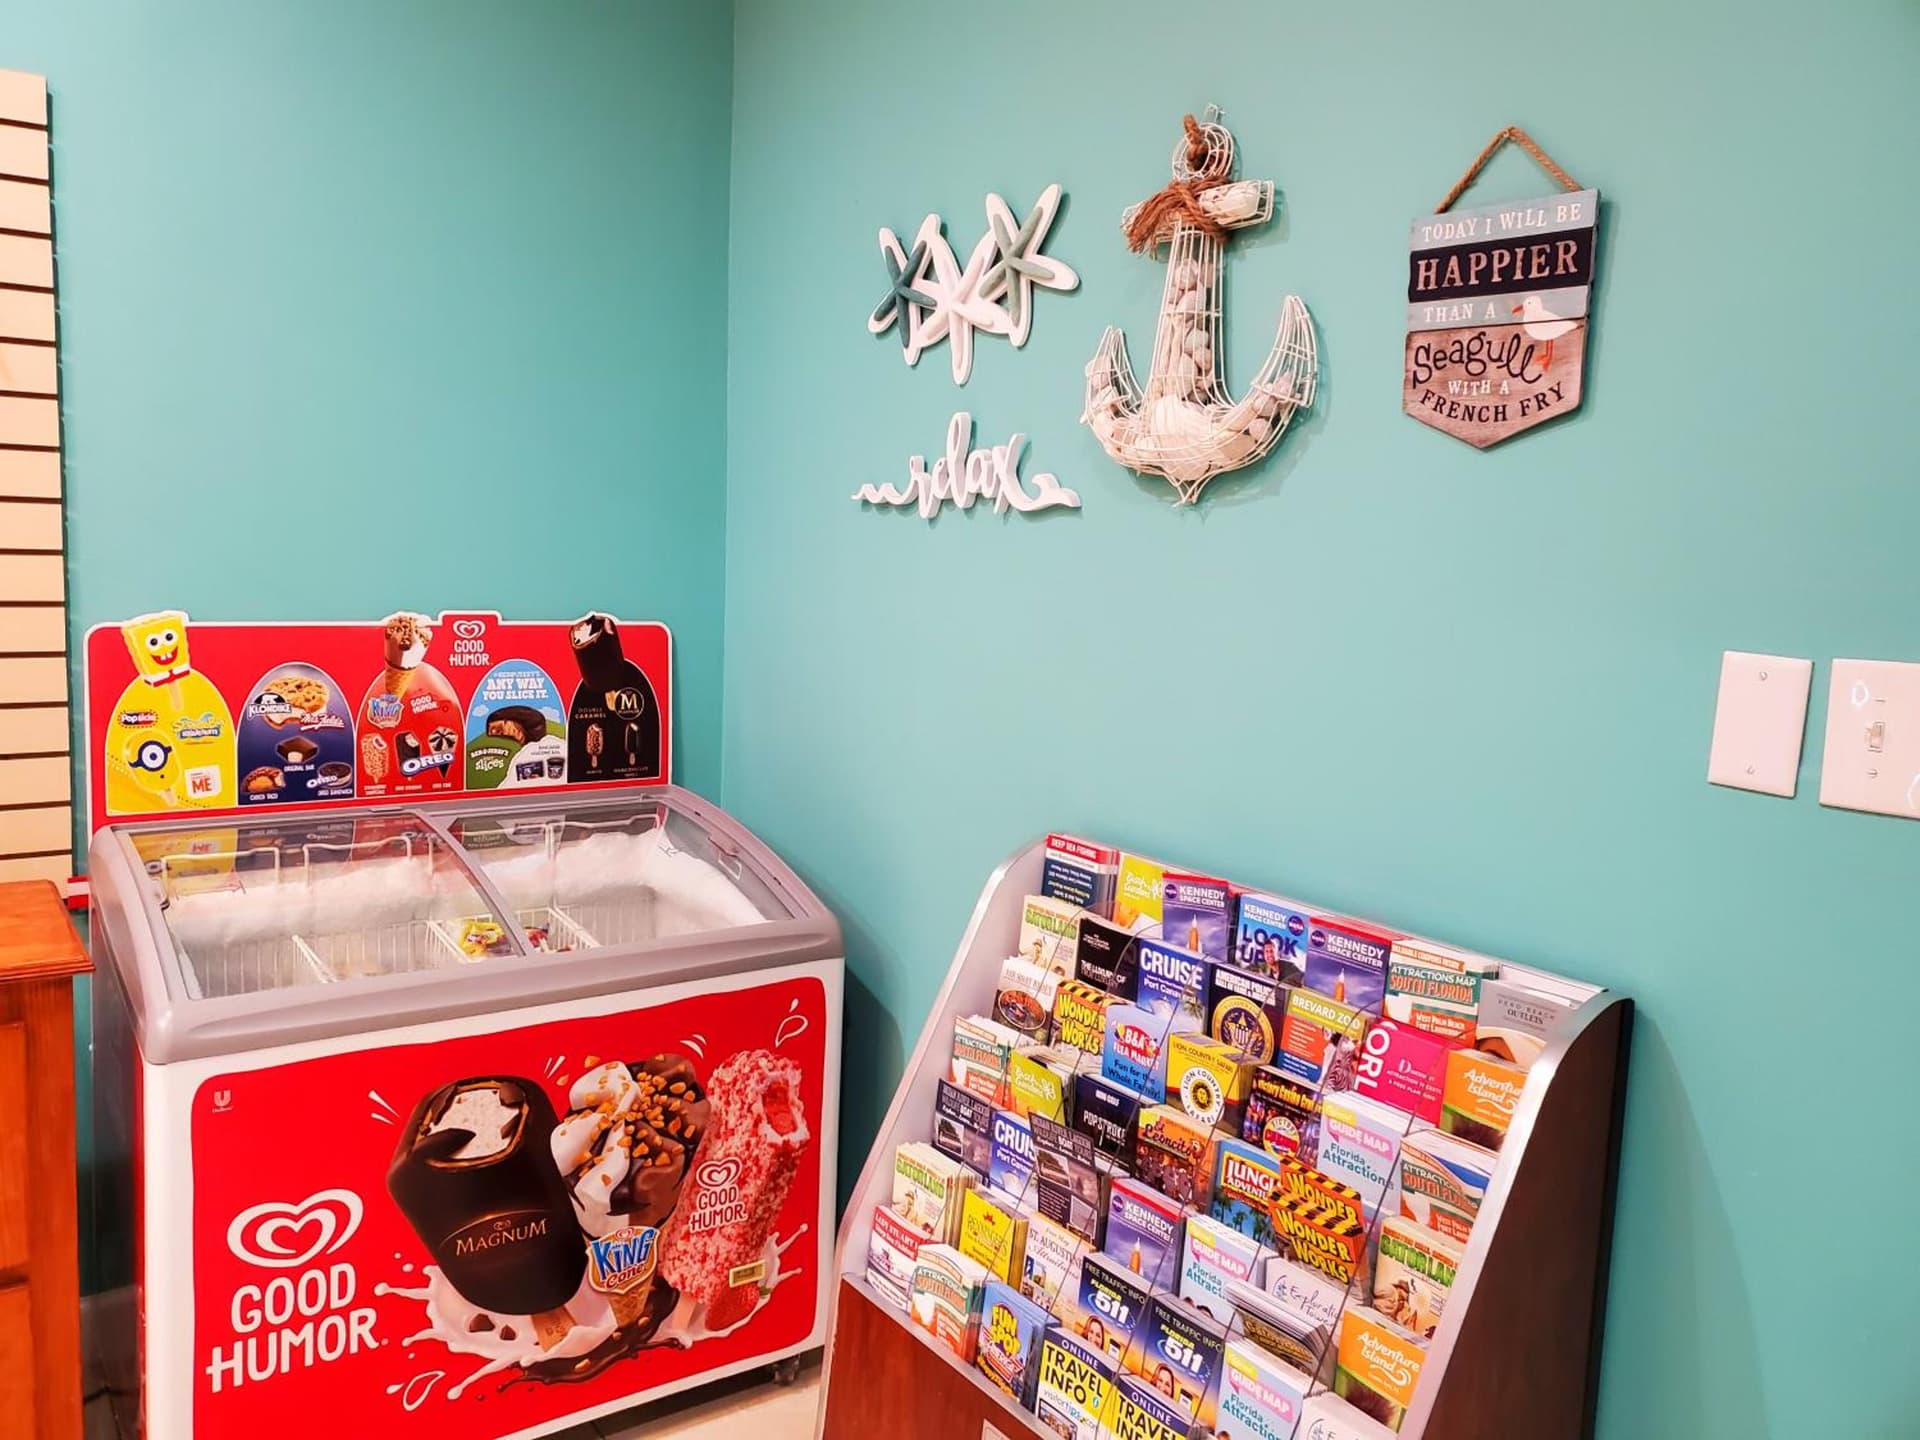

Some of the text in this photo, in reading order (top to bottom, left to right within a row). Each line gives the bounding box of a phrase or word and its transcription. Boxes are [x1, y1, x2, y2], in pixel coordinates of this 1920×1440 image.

[1421, 203, 1582, 242] TODAY I WILL BE
[1416, 239, 1578, 291] HAPPIER
[1424, 303, 1497, 323] THAN A
[1411, 331, 1543, 390] Seagull
[1420, 382, 1565, 423] FRENCH FRY
[1447, 380, 1511, 396] WITH A
[449, 653, 490, 666] HUMOR
[453, 640, 485, 653] GOOD
[482, 690, 505, 700] YOU
[505, 690, 534, 700] SLICE
[486, 677, 545, 690] ANY WAY
[248, 703, 290, 717] KLONDIKE
[620, 693, 637, 710] M
[403, 753, 454, 772] OREO
[475, 759, 504, 771] slices
[192, 777, 213, 793] ME
[1179, 885, 1225, 901] KENNEDY
[1179, 895, 1225, 908] SPACE CENTER
[1244, 903, 1287, 923] KENNEDY
[1263, 918, 1287, 930] CENTER
[1243, 924, 1299, 958] LOOK
[1327, 934, 1385, 959] KENNEDY
[1141, 948, 1204, 990] CRUISE
[1327, 944, 1351, 959] SPACE
[1352, 952, 1384, 968] CENTER
[1390, 974, 1473, 1003] SOUTH FLORIDA
[1391, 966, 1476, 986] ATTRACTIONS MAP
[1293, 995, 1361, 1031] BREVARD ZOO
[1507, 1007, 1545, 1026] OUTLETS
[1061, 1019, 1100, 1055] WORKS
[1112, 1041, 1129, 1057] FLEA
[1125, 1028, 1146, 1051] B&A
[1115, 1059, 1129, 1072] Fun
[1129, 1066, 1141, 1077] for
[1354, 1028, 1390, 1089] ORL
[1467, 1082, 1506, 1103] Island
[1083, 1109, 1127, 1146] POPSTROKE
[1329, 1119, 1391, 1152] GUIDE MAP
[1331, 1142, 1366, 1165] Florida
[698, 1186, 738, 1211] GOOD
[1286, 1172, 1359, 1225] WONDER
[690, 1203, 747, 1231] HUMOR
[1124, 1201, 1174, 1233] KENNEDY
[1124, 1212, 1147, 1230] SPACE
[456, 1219, 547, 1256] MAGNUM
[1275, 1207, 1353, 1263] WONDER
[1191, 1238, 1245, 1276] GUIDE MAP
[1291, 1236, 1350, 1285] WORKS
[606, 1263, 645, 1289] Cone
[1085, 1261, 1099, 1277] FREE
[1100, 1271, 1128, 1296] TRAFFIC
[1192, 1261, 1223, 1287] Florida
[231, 1263, 356, 1333] GOOD
[1094, 1290, 1131, 1325] 511
[991, 1304, 1018, 1337] FUN
[1154, 1305, 1170, 1321] FREE
[1171, 1315, 1202, 1344] TRAFFIC
[1202, 1334, 1224, 1352] INFO
[206, 1307, 380, 1393] HUMOR
[1159, 1323, 1195, 1350] FLORIDA
[1061, 1338, 1099, 1370] ONLINE
[1164, 1336, 1204, 1374] 511
[1357, 1331, 1421, 1373] Adventure
[1361, 1346, 1397, 1374] Island
[1044, 1345, 1104, 1398] TRAVEL
[1044, 1365, 1087, 1405] INFO
[1230, 1371, 1290, 1414] GUIDE MAP
[1131, 1391, 1173, 1427] ONLINE
[1229, 1393, 1264, 1423] Florida
